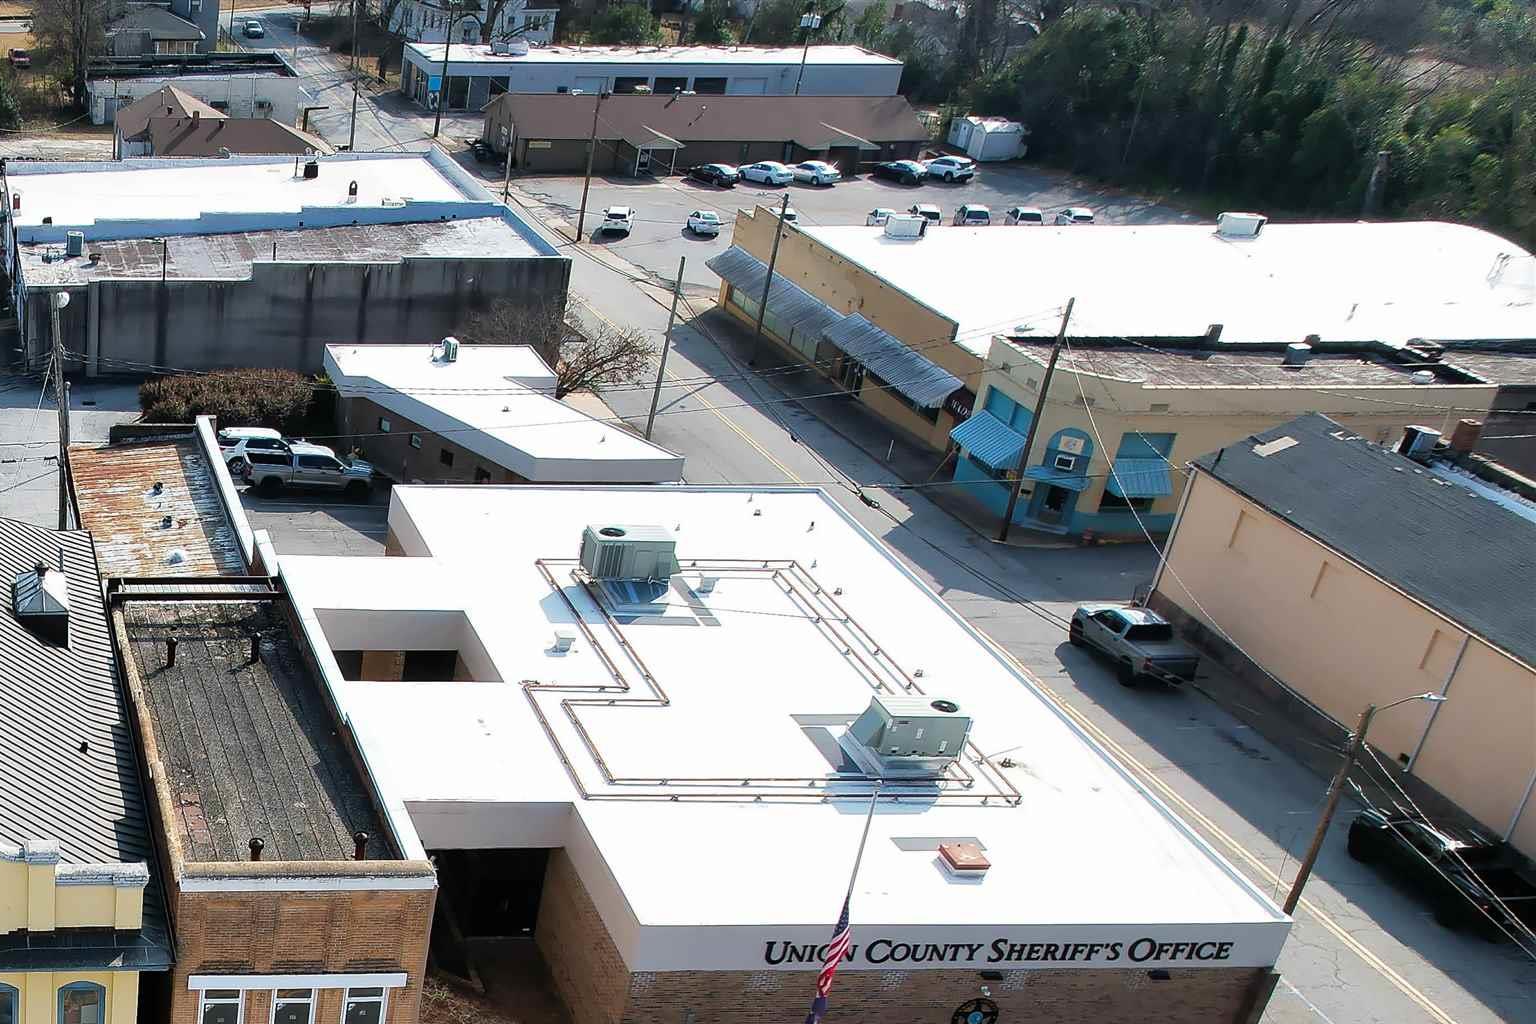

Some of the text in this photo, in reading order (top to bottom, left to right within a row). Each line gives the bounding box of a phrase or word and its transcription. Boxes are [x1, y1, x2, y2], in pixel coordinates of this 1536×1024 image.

[865, 939, 984, 964] COUNTY
[987, 938, 1123, 963] SHERIFF'S
[1128, 937, 1234, 962] OFFICE
